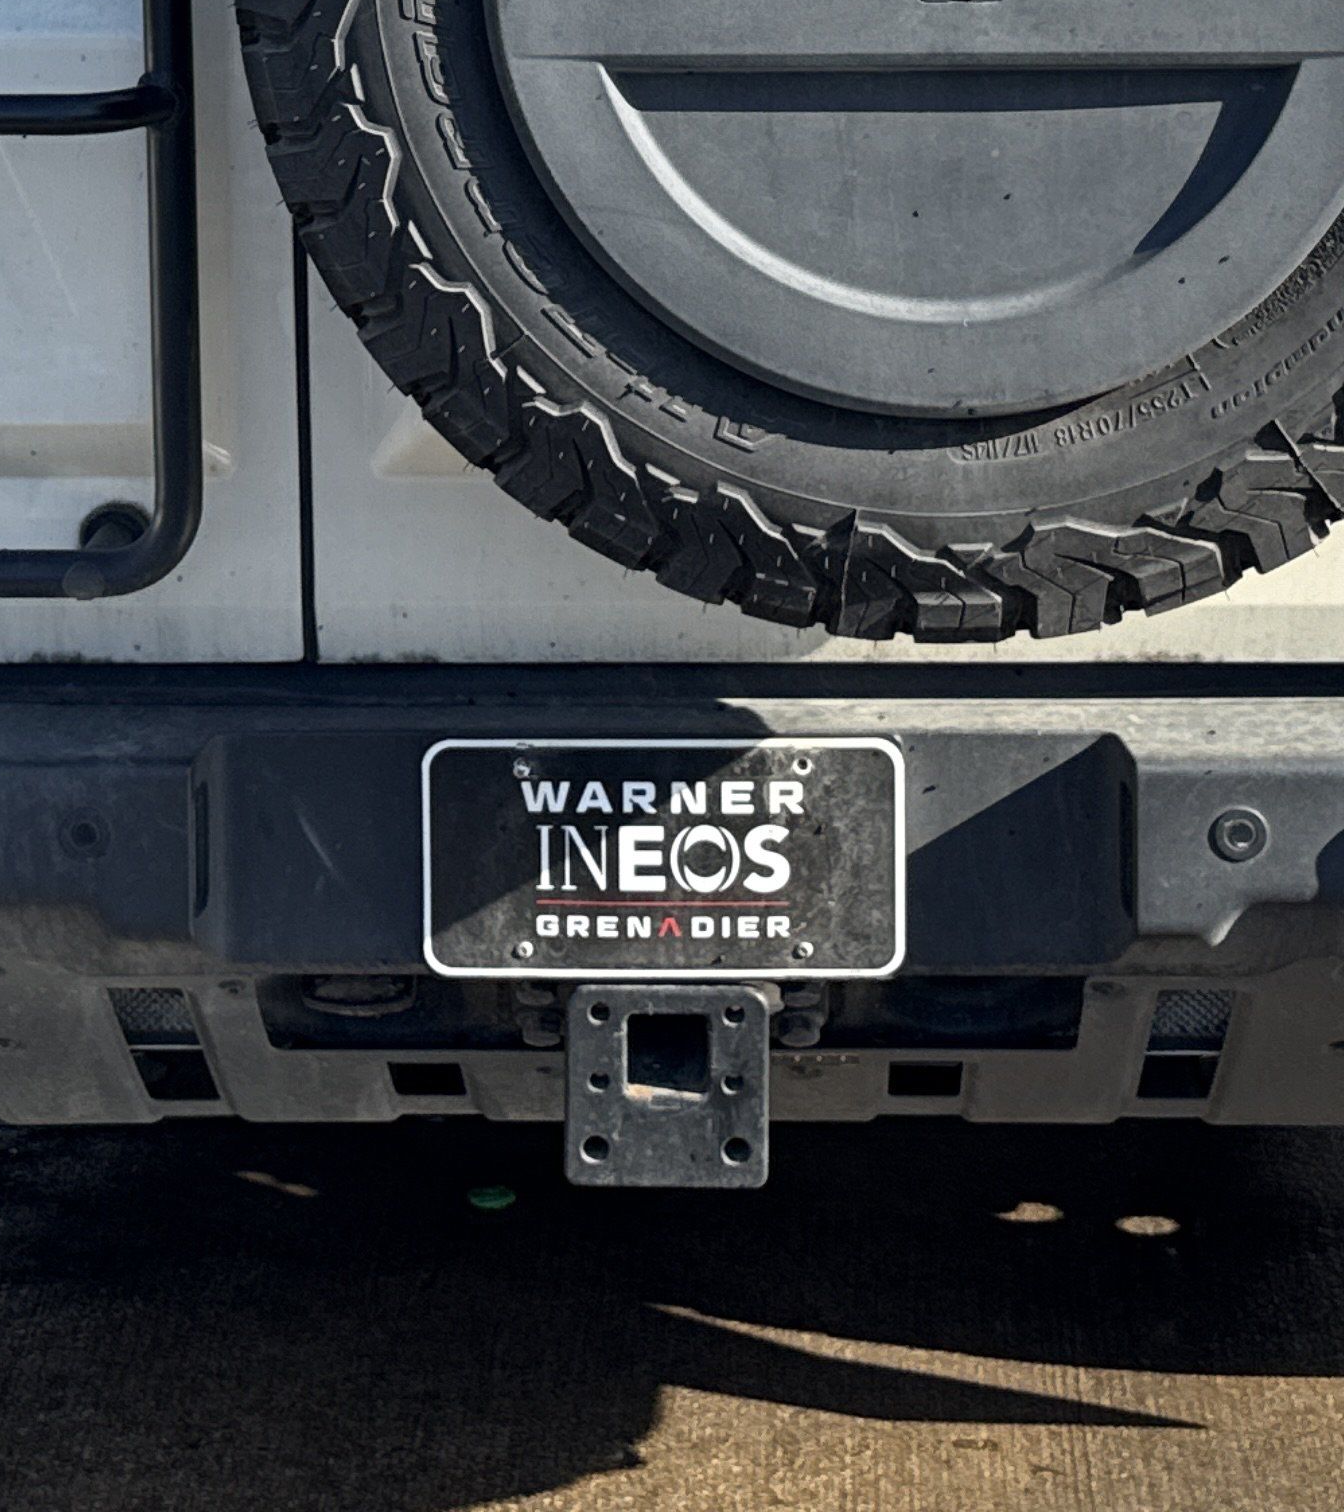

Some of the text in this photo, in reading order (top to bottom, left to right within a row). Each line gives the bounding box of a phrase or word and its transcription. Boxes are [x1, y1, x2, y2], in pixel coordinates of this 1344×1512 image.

[520, 780, 805, 815] WARNER
[535, 824, 791, 893] INEOS
[535, 914, 791, 938] GRENADIER
